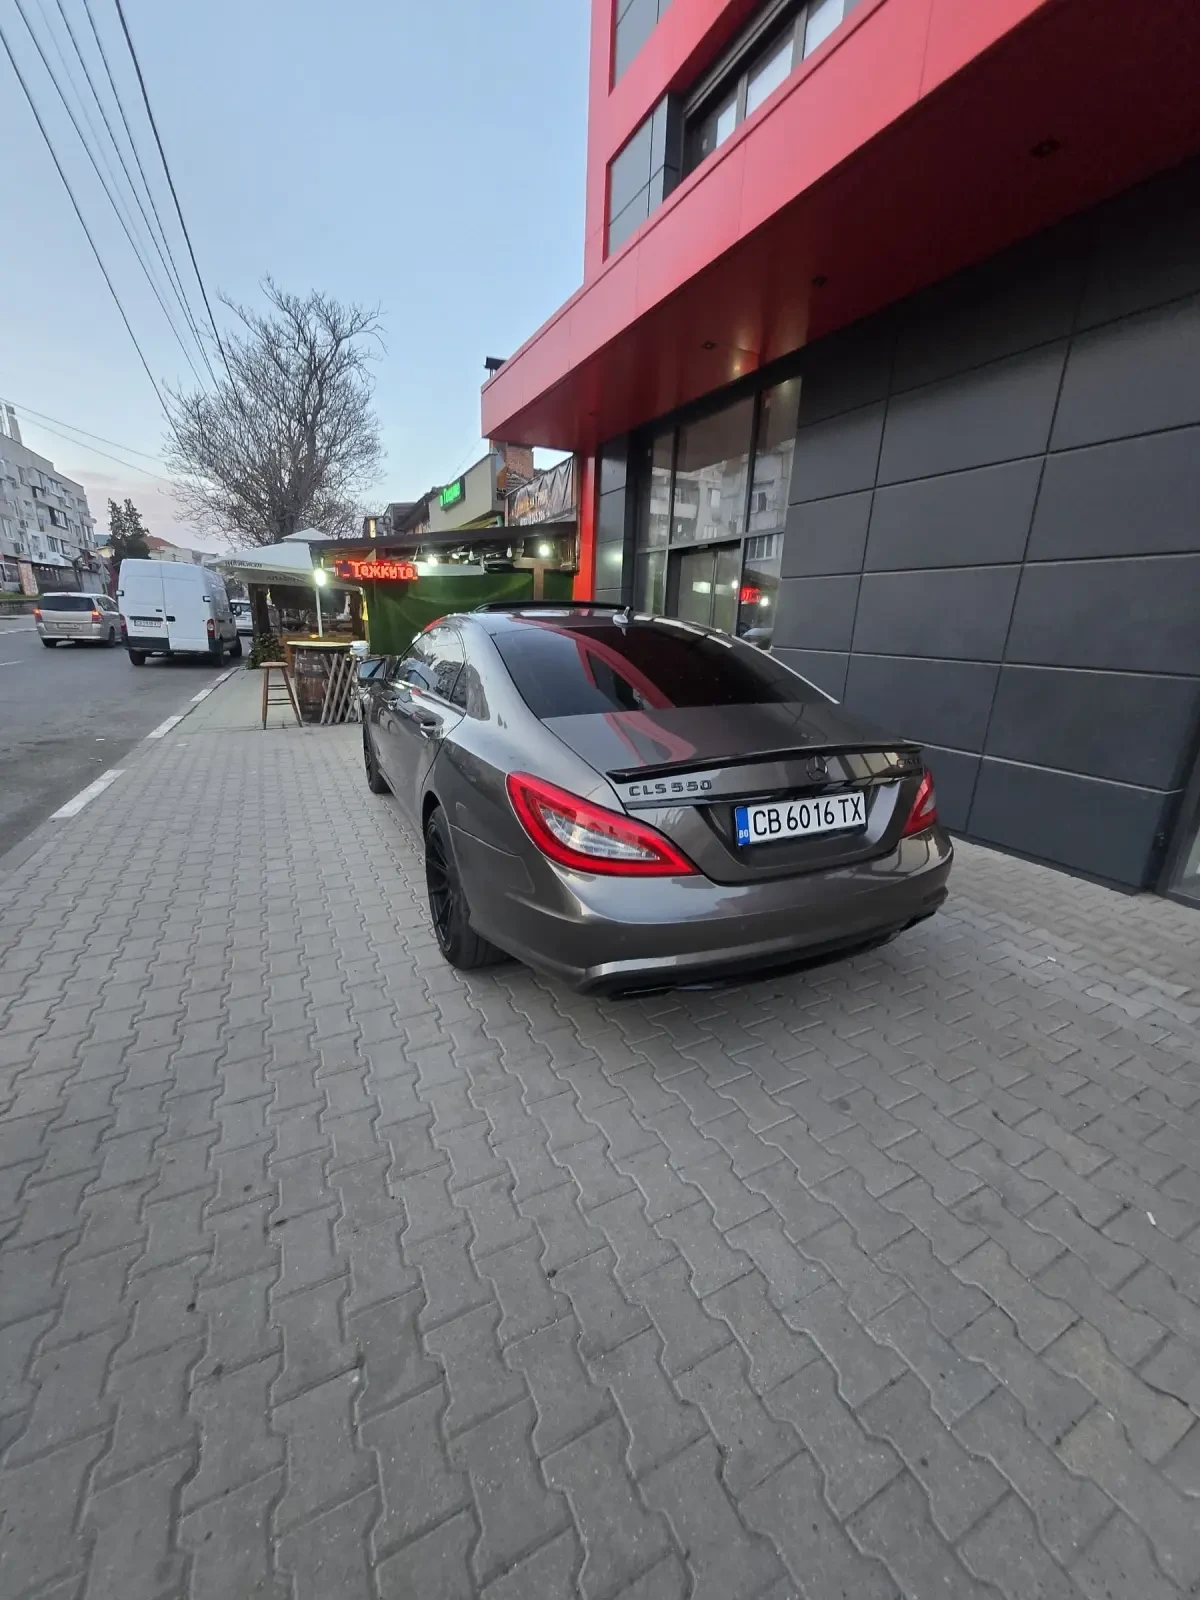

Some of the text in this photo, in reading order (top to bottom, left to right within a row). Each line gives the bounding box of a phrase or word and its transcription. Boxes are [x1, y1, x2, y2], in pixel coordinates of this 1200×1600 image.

[628, 780, 712, 797] CLS 550
[752, 796, 862, 836] CB 6016 TX
